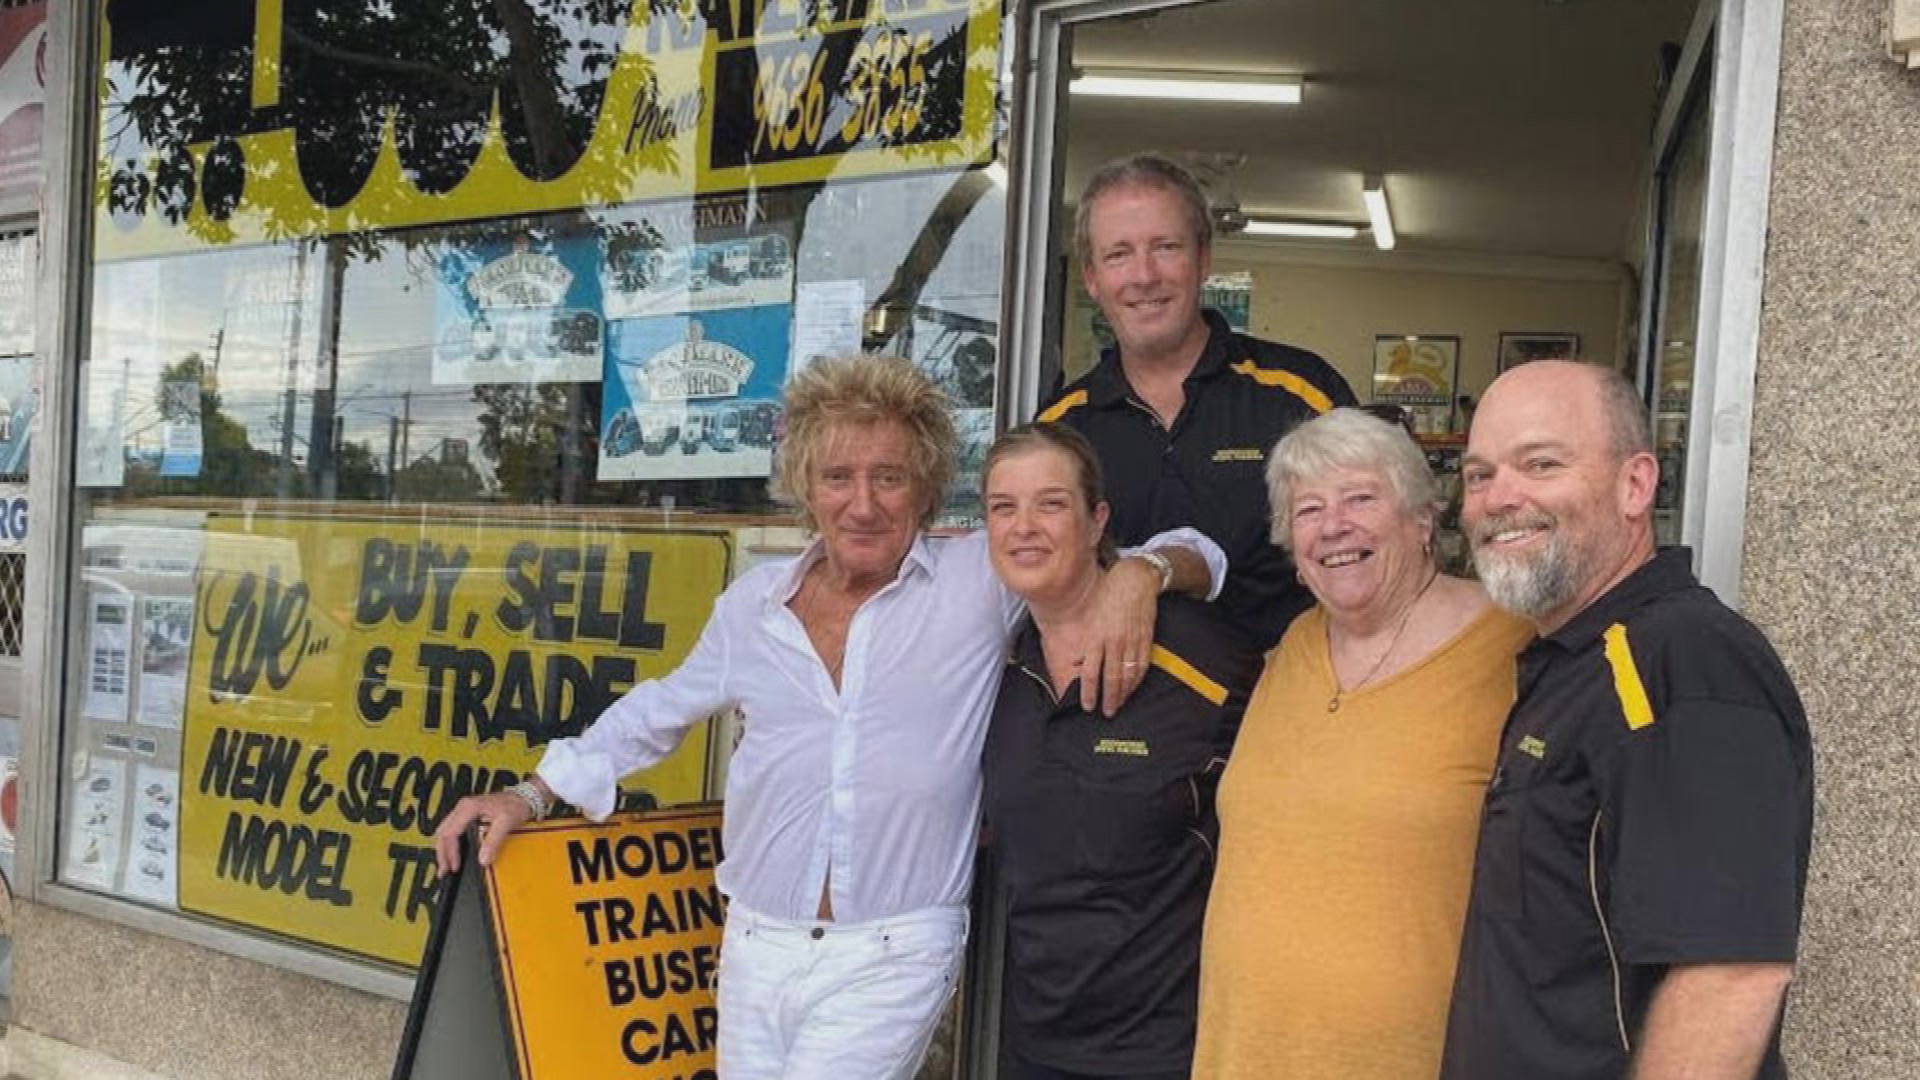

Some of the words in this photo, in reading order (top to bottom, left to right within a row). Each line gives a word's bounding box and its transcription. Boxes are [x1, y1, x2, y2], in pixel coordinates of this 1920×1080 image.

[752, 50, 829, 157] 9636
[355, 537, 479, 639] BUY,
[495, 541, 667, 650] SELL
[357, 646, 403, 722] &
[417, 643, 637, 748] TRADE
[200, 727, 301, 809] NEW
[300, 749, 335, 815] &
[216, 811, 353, 907] MODEL
[575, 884, 731, 946] TRAIN
[604, 945, 719, 1007] BUSE
